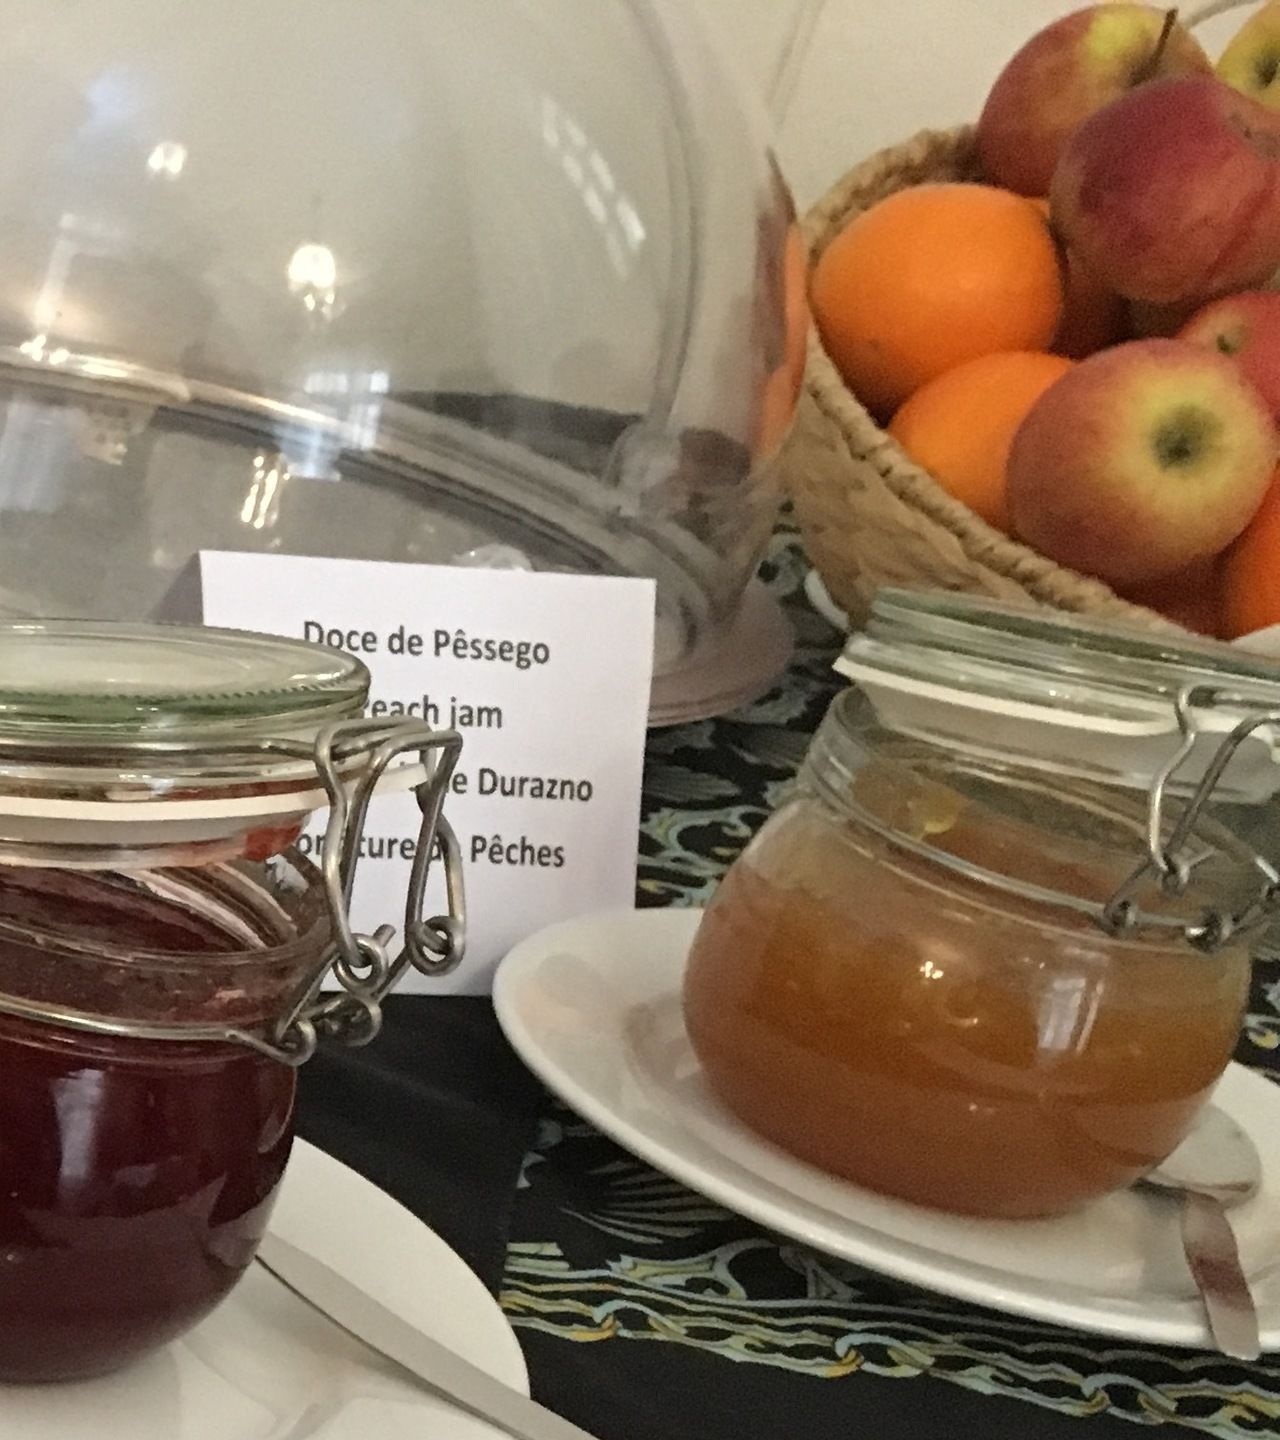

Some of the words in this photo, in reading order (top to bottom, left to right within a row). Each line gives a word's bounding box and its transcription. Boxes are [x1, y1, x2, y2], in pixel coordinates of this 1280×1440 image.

[303, 620, 378, 652] Doce
[388, 624, 424, 657] de
[433, 628, 551, 671] Pêssego
[364, 694, 440, 726] each
[449, 696, 503, 733] jam
[477, 766, 594, 804] Durazno
[470, 833, 566, 870] Pêches
